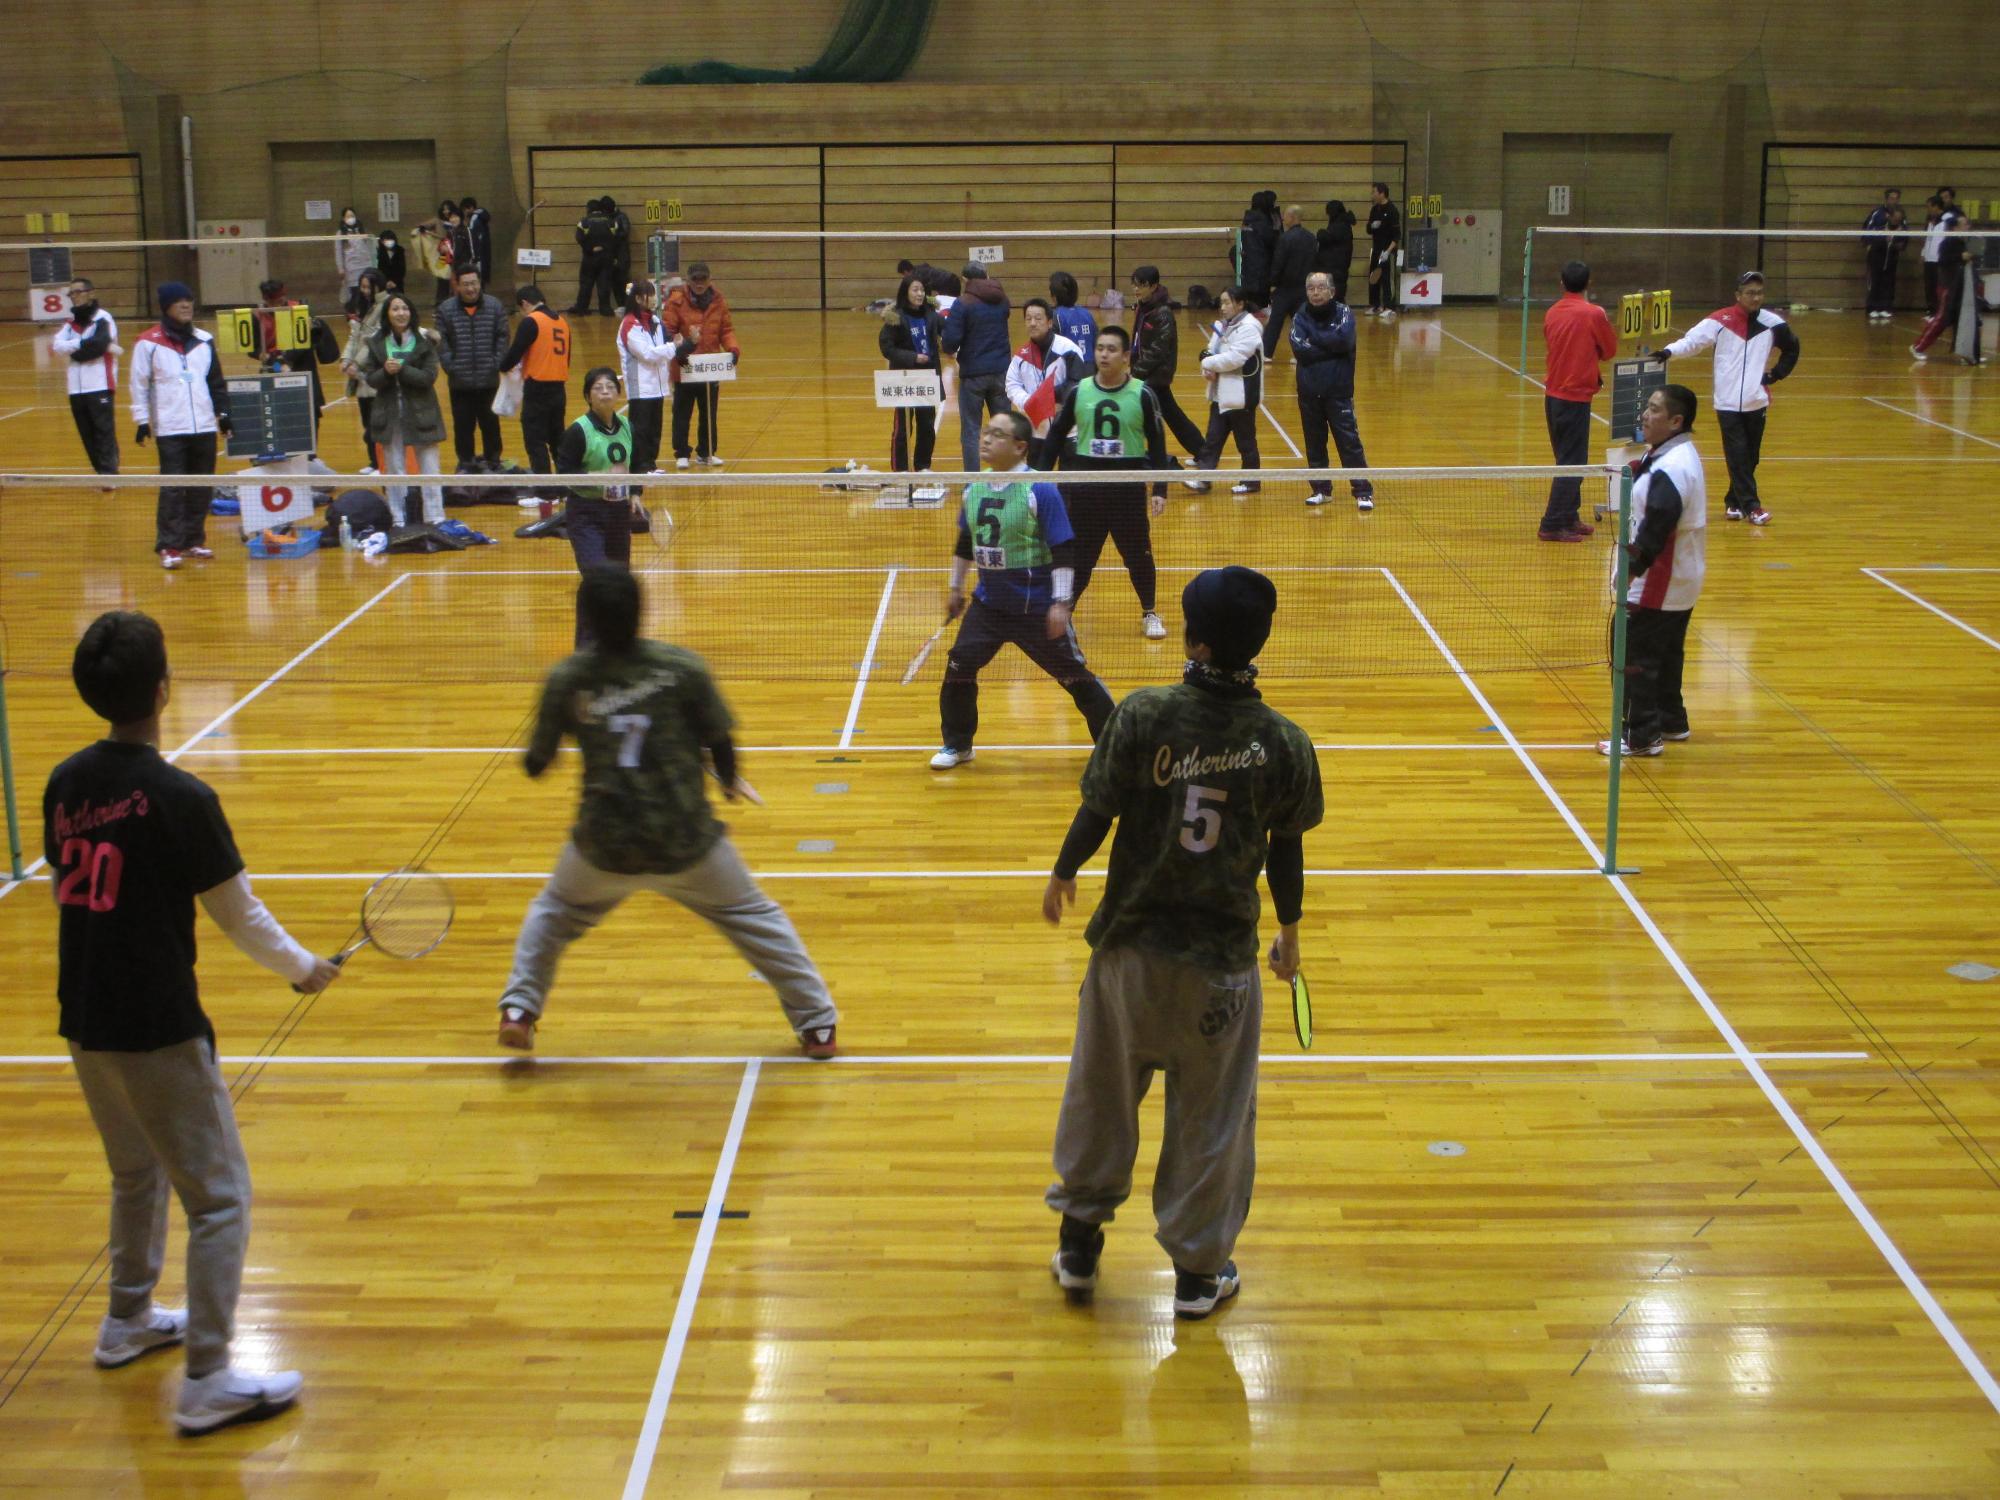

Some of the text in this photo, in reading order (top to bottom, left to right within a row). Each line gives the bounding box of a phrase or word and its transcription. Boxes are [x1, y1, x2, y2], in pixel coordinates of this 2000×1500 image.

[43, 294, 63, 313] 8
[1410, 279, 1430, 297] 4
[239, 316, 308, 348] 0 0
[553, 328, 566, 356] 5
[1070, 324, 1091, 336] 平田
[881, 385, 936, 398] 城東体振B
[1093, 399, 1121, 441] 6
[976, 497, 1006, 548] 5
[608, 714, 652, 768] 7
[1179, 784, 1229, 853] 5
[59, 838, 124, 912] 20
